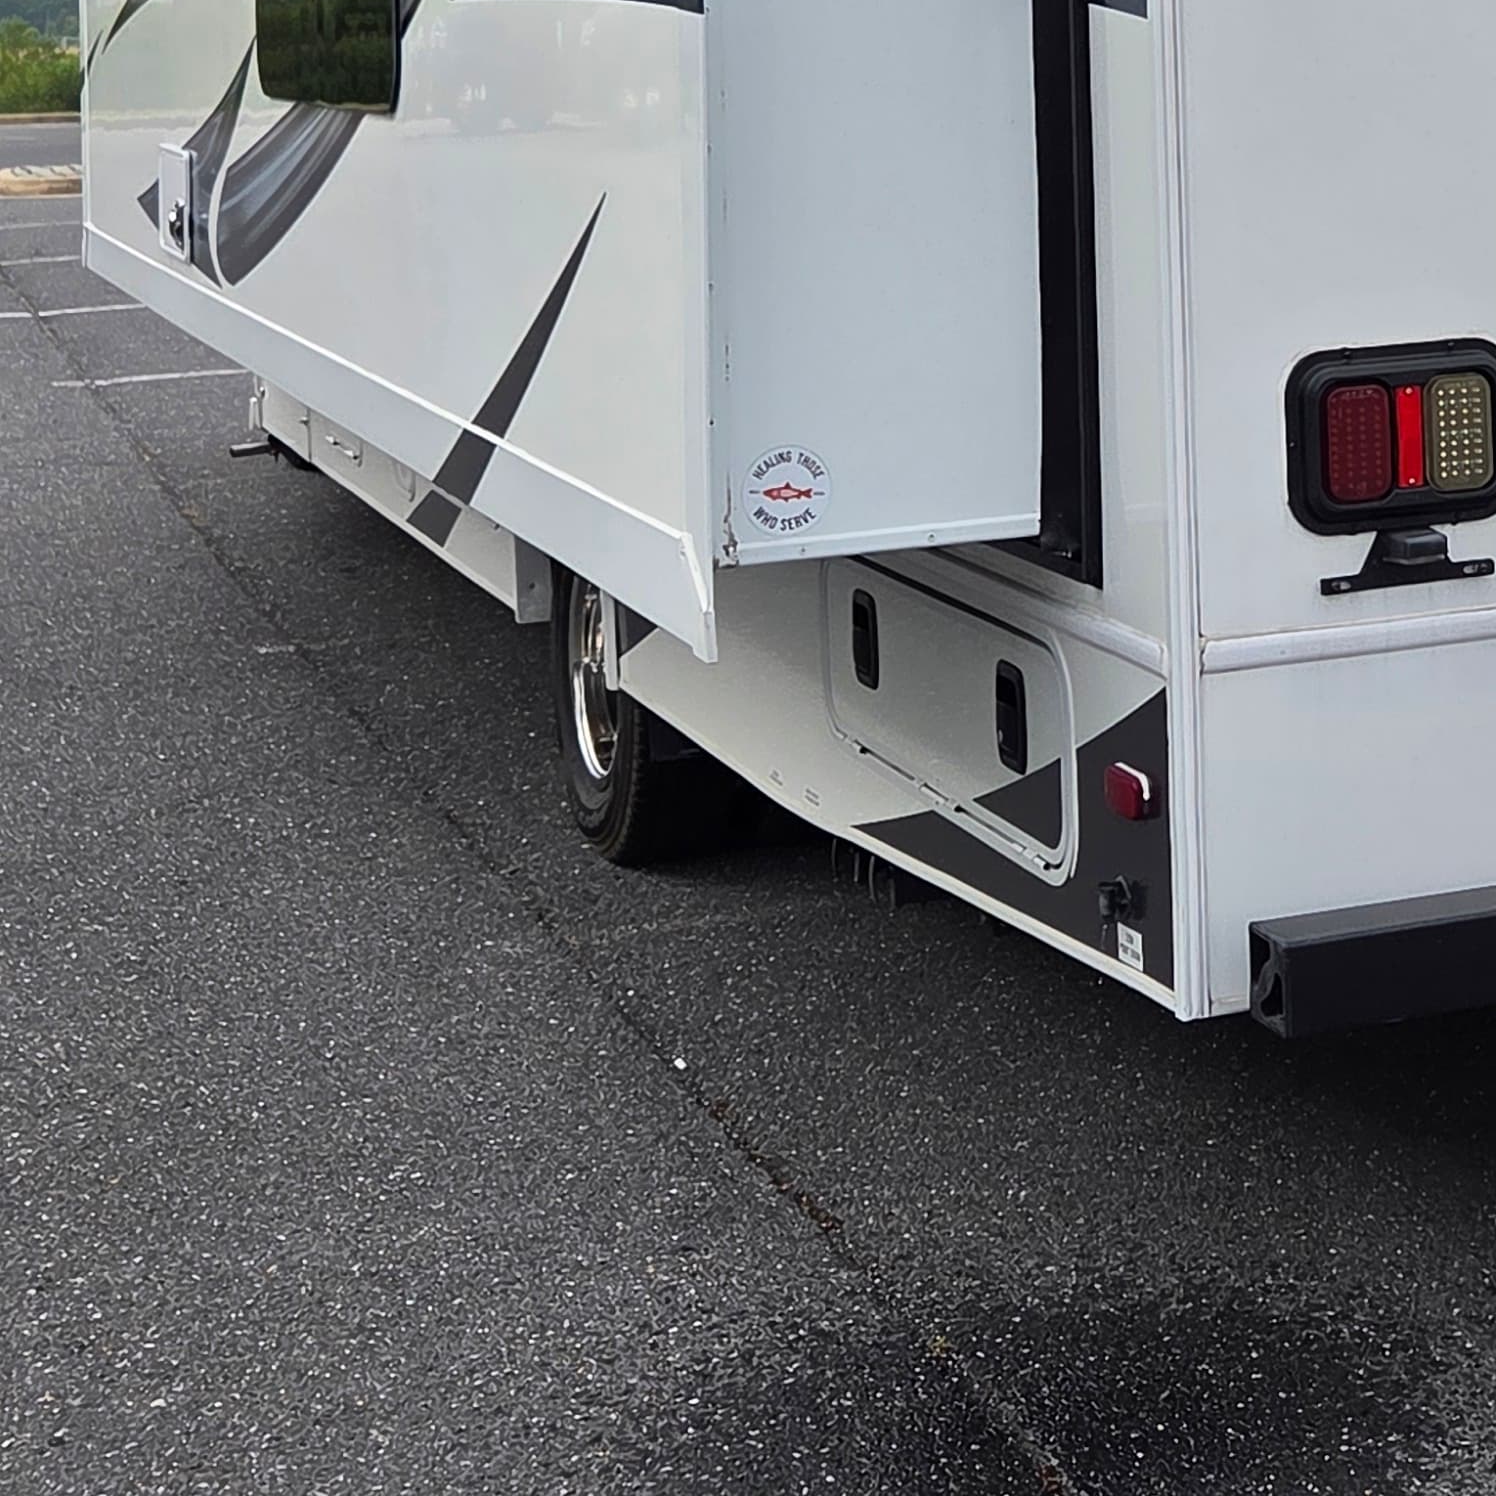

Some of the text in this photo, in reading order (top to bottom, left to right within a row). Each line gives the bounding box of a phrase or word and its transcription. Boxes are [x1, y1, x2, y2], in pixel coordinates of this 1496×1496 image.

[797, 453, 825, 480] THOSE
[753, 506, 816, 531] WHO SERVE
